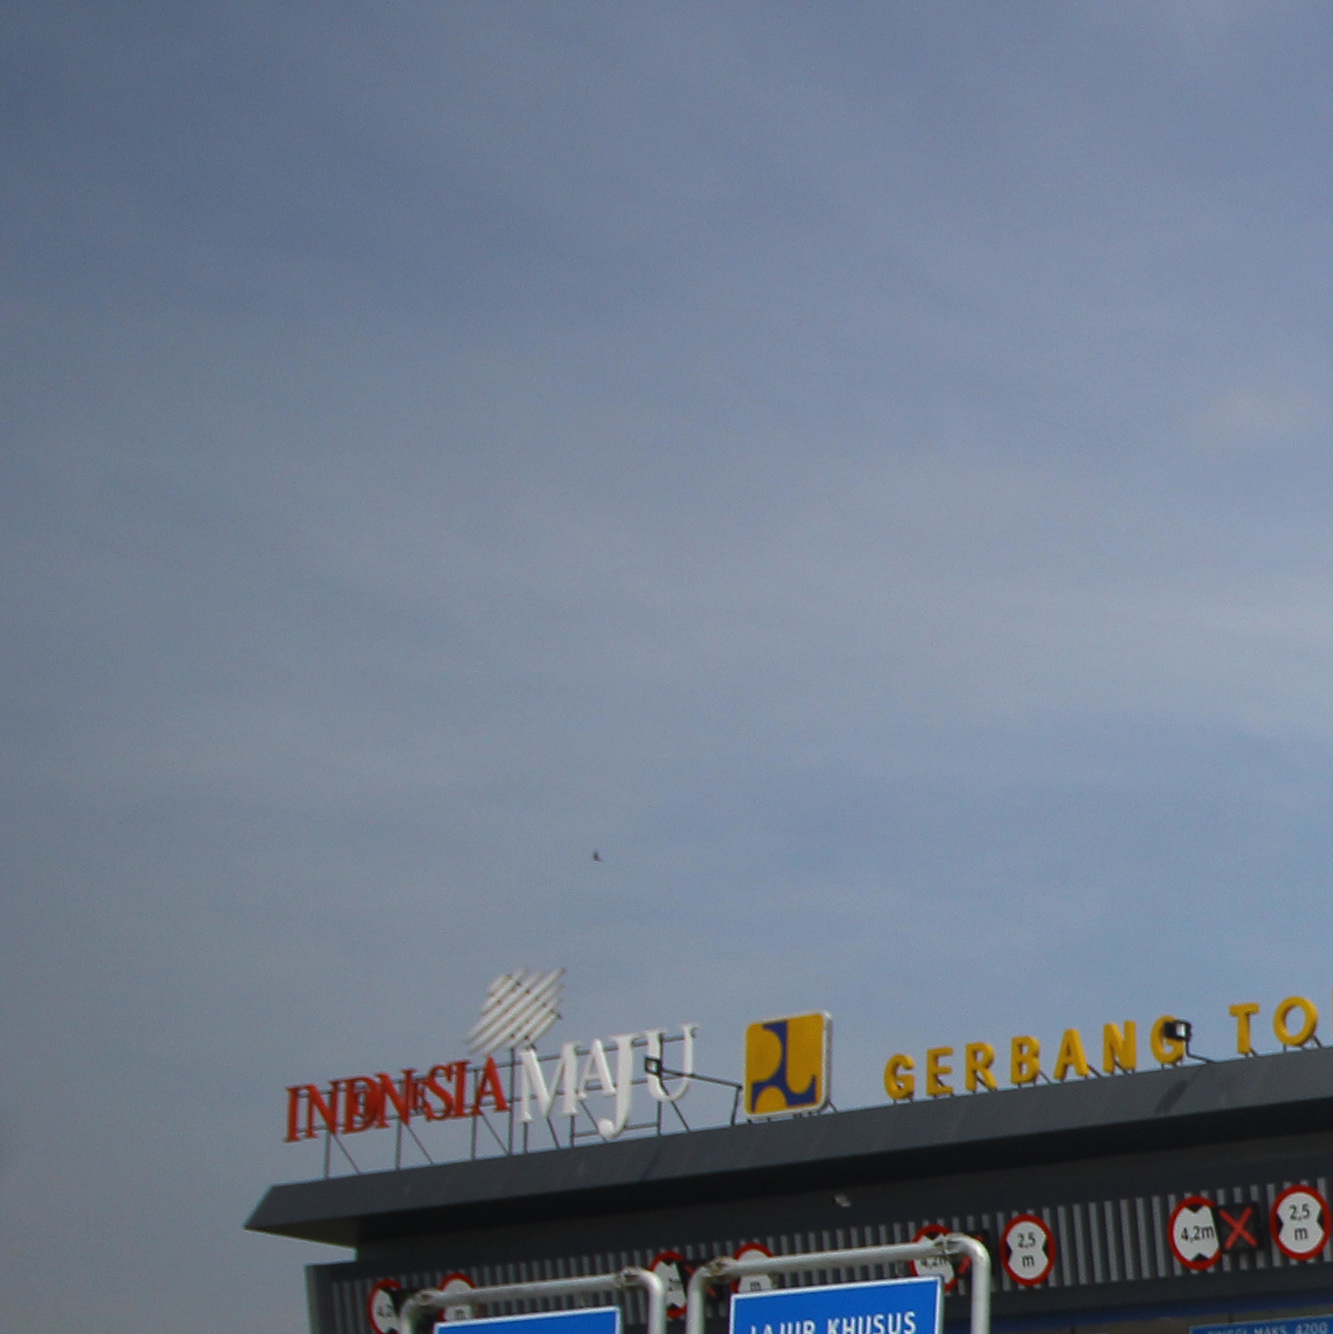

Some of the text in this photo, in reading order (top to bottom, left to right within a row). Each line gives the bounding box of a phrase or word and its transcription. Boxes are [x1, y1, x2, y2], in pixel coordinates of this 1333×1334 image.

[884, 1014, 1186, 1101] GERBANG
[518, 1022, 700, 1139] MAJU
[1289, 1204, 1311, 1221] 2,5
[1017, 1232, 1036, 1248] 2,5
[1181, 1224, 1215, 1243] 4,2m
[1294, 1227, 1308, 1241] m
[1022, 1255, 1035, 1267] m
